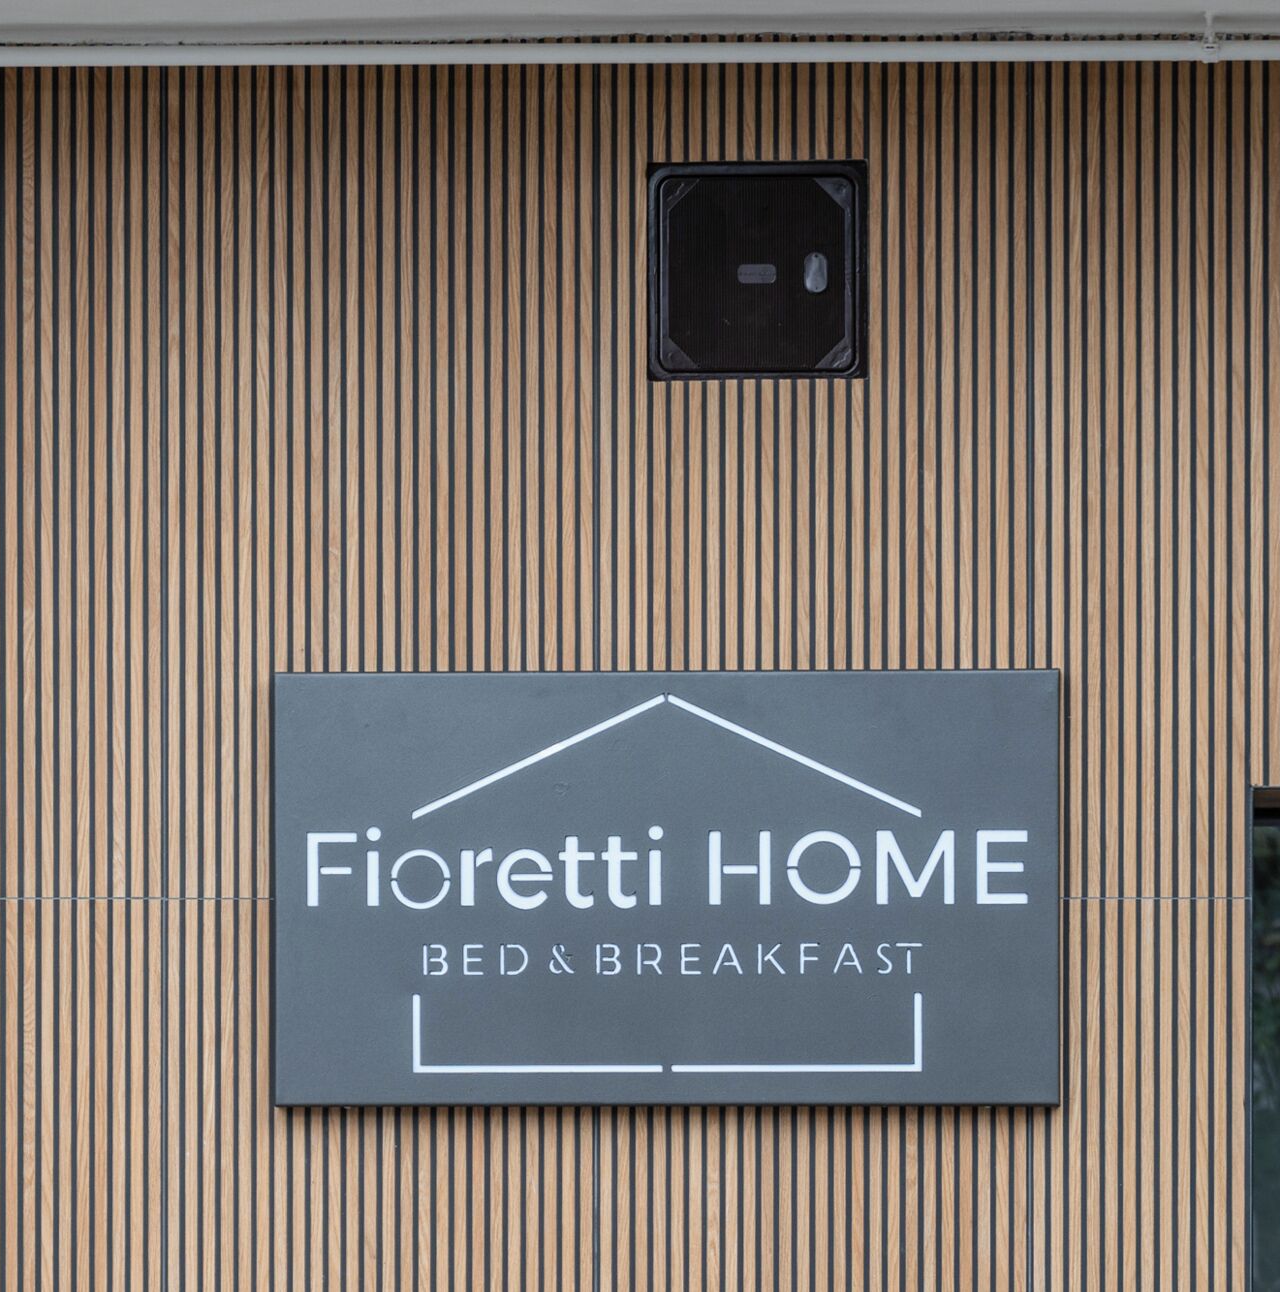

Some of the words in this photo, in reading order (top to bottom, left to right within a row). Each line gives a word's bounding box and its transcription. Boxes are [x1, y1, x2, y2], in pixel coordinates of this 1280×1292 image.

[306, 826, 663, 910] Fioretti
[708, 829, 1029, 906] HOME
[422, 942, 529, 976] BED
[548, 943, 575, 976] &
[595, 941, 924, 976] BREAKFAST
